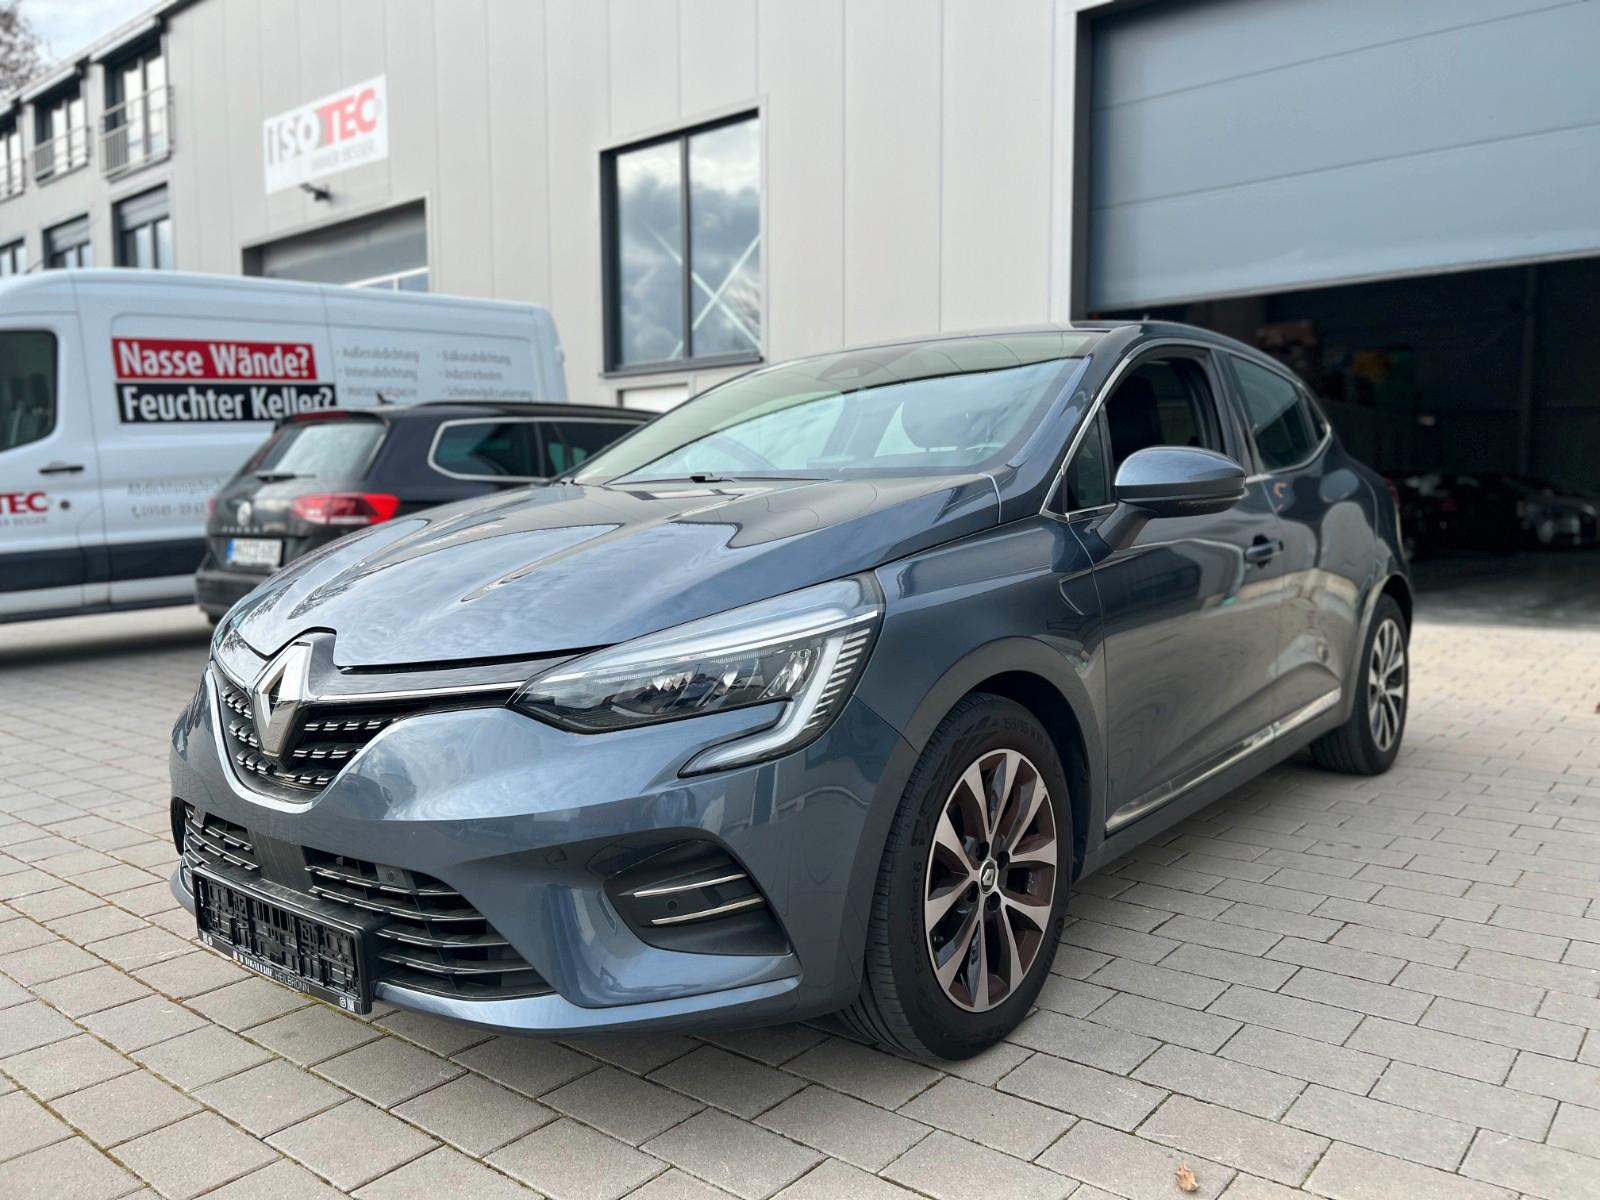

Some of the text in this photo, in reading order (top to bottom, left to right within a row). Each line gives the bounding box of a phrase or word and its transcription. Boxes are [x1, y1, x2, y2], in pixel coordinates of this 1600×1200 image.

[267, 87, 378, 165] ISOTEC
[118, 341, 310, 377] Nasse Wände?
[122, 386, 245, 421] Feuchter
